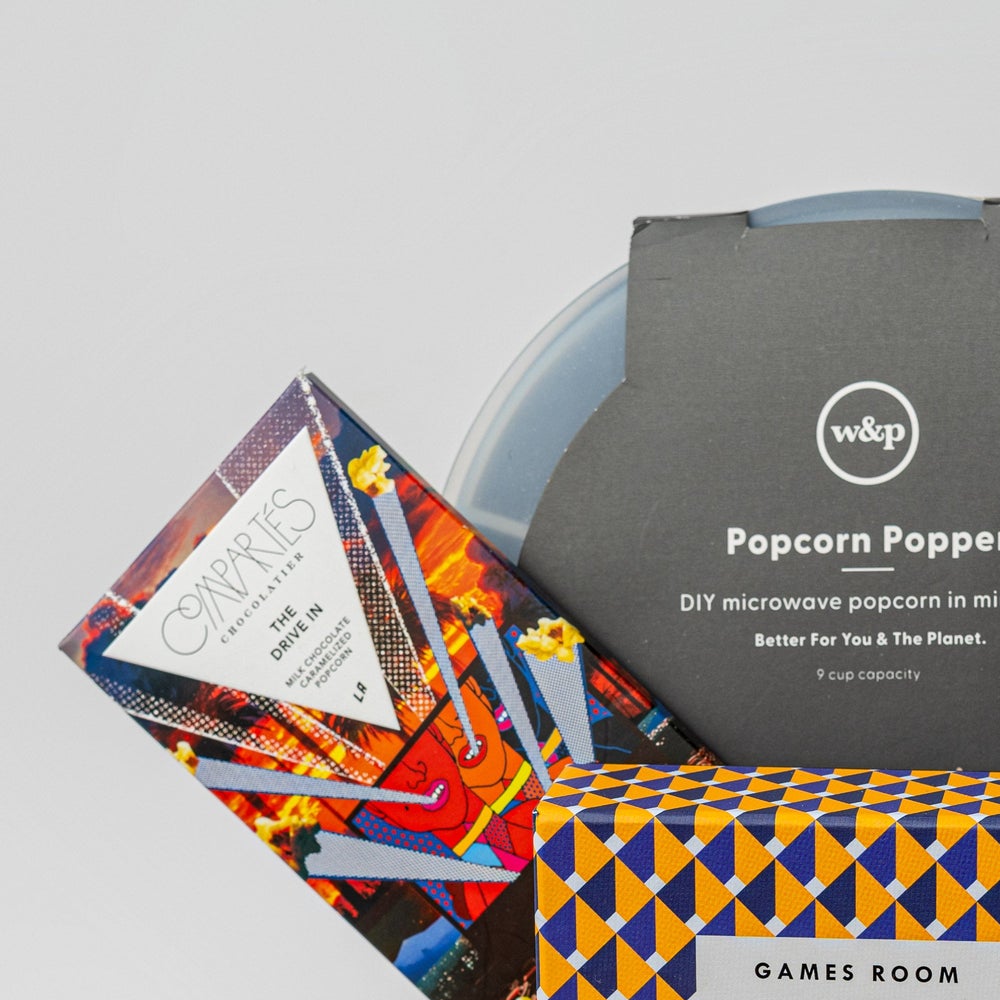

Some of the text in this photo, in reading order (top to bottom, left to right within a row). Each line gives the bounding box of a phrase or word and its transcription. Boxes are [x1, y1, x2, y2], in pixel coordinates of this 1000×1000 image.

[830, 415, 906, 451] w&p
[726, 526, 872, 561] Popcorn
[220, 551, 304, 644] CHOCOLATIER
[679, 593, 716, 612] DIY
[722, 592, 842, 611] microwave
[848, 593, 941, 614] popcorn
[947, 591, 967, 609] in
[269, 605, 298, 633] THE
[270, 602, 324, 662] DRIVE IN
[285, 615, 352, 689] MILK CHOCOLATE
[754, 631, 987, 647] Better For You & The Planet.
[299, 631, 352, 689] CARAMELIZED
[314, 646, 354, 689] POPCORN
[816, 668, 921, 683] 9 cup capacity
[754, 962, 959, 984] GAMES ROOM
